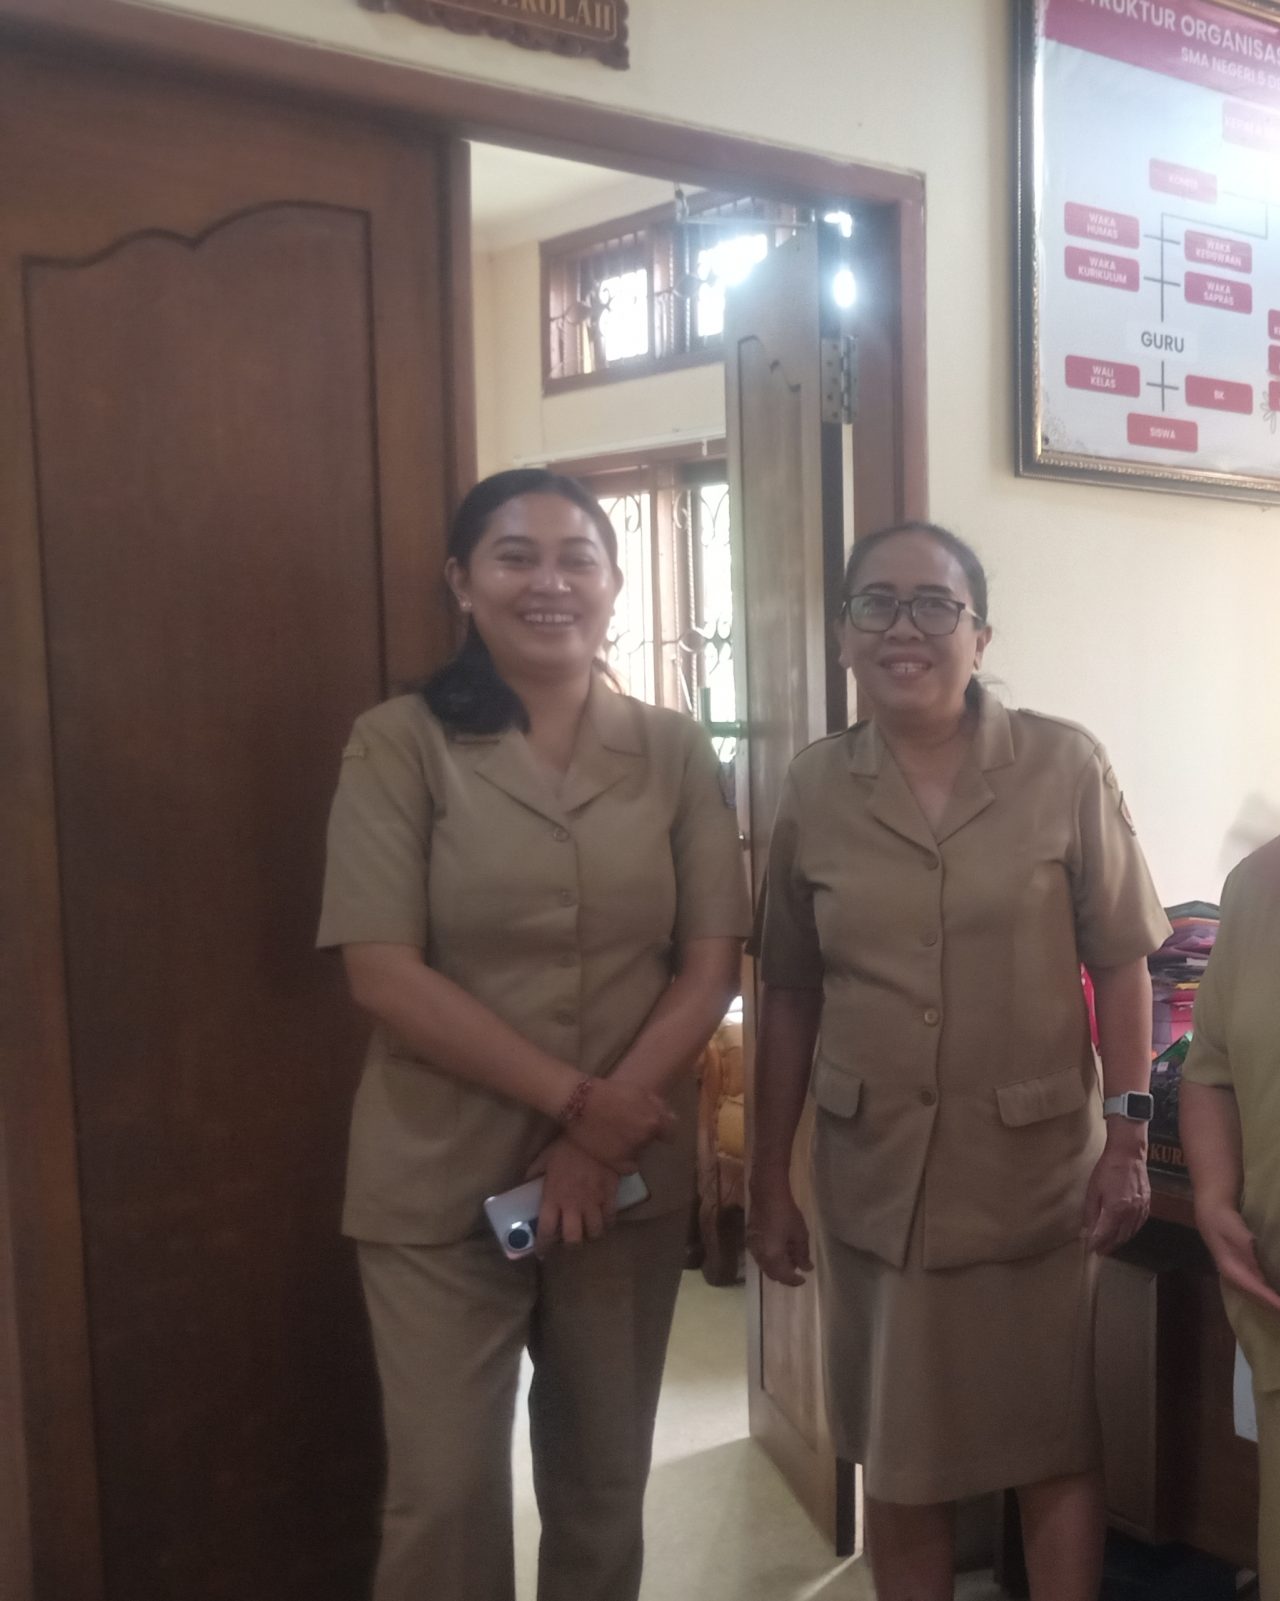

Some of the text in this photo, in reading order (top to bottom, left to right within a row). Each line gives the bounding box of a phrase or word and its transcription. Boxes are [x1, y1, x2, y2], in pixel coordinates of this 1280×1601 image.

[1078, 0, 1176, 31] RUKTUR
[1181, 47, 1209, 67] SMA
[1212, 56, 1255, 82] NEGERI
[1088, 212, 1117, 227] WAKA
[1086, 223, 1119, 240] HUMAS
[1206, 239, 1231, 254] WAKA
[1088, 256, 1117, 271] WAKA
[1077, 265, 1128, 284] KURIKULUM
[1206, 281, 1231, 295] WAKA
[1140, 330, 1185, 353] GURU
[1092, 365, 1115, 377] WALI
[1090, 376, 1117, 389] KELAS
[1213, 389, 1225, 401] BK
[1149, 427, 1176, 440] SISWA
[1151, 1143, 1184, 1166] KUR
